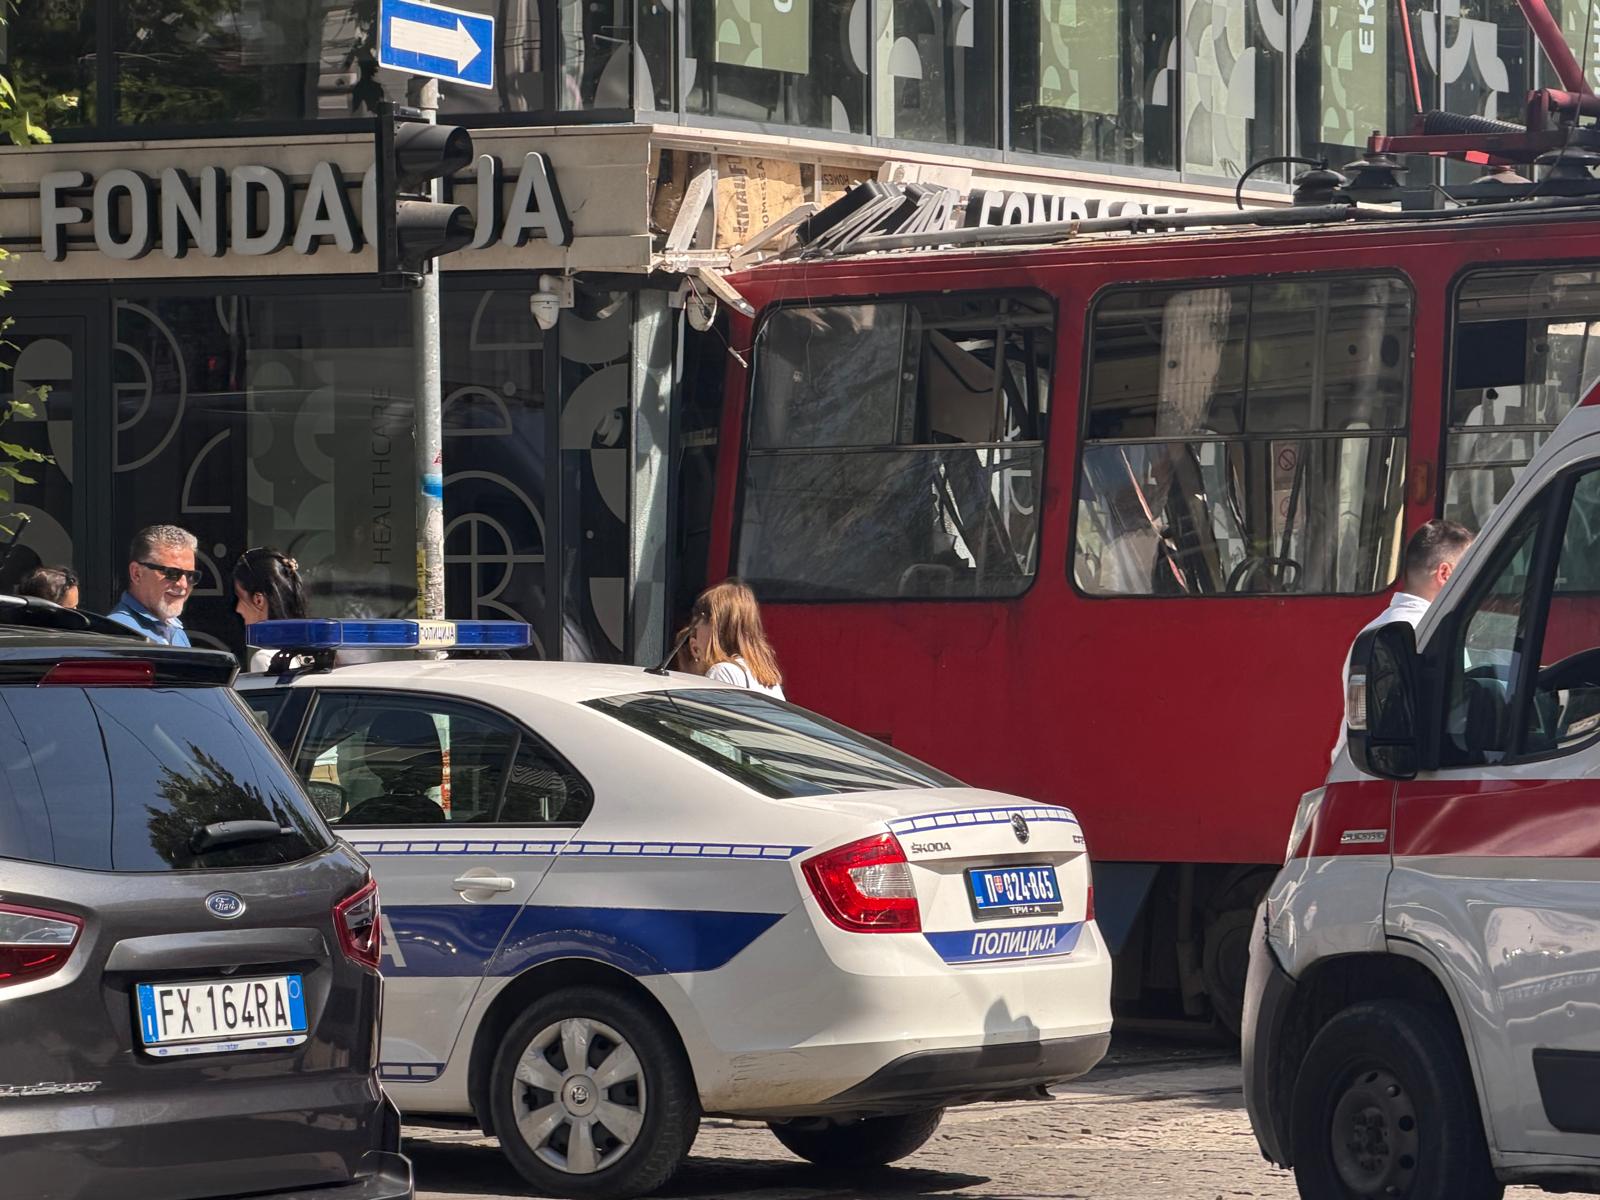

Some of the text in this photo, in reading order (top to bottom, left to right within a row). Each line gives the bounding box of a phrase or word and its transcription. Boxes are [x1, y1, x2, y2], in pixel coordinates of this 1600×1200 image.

[40, 152, 572, 261] FONDAJA
[371, 384, 391, 565] HEALTHCARE
[911, 842, 952, 854] ŠKODA
[972, 928, 1056, 956] ПОЛИЦИЈА
